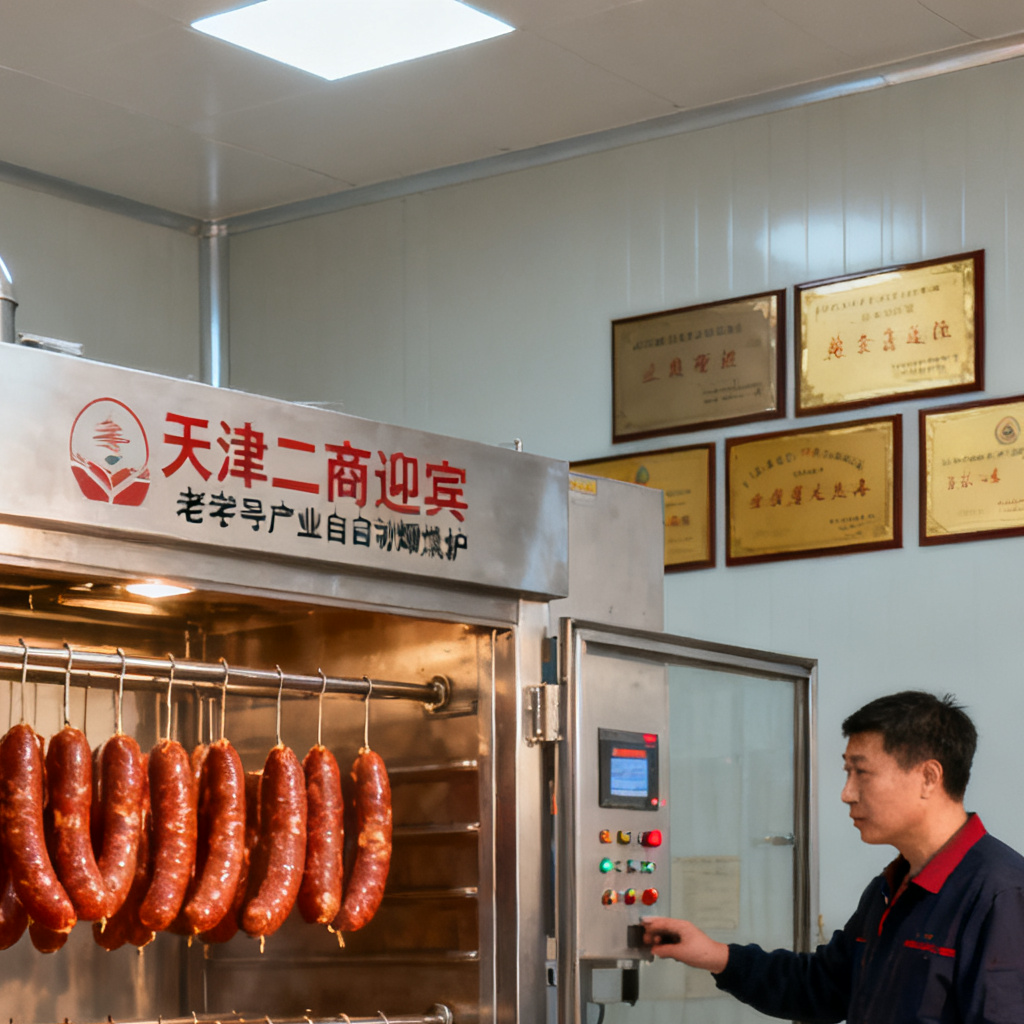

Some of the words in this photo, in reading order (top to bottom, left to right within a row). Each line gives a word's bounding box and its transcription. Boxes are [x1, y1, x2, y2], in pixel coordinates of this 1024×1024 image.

[162, 412, 469, 523] 天津二商迎宾
